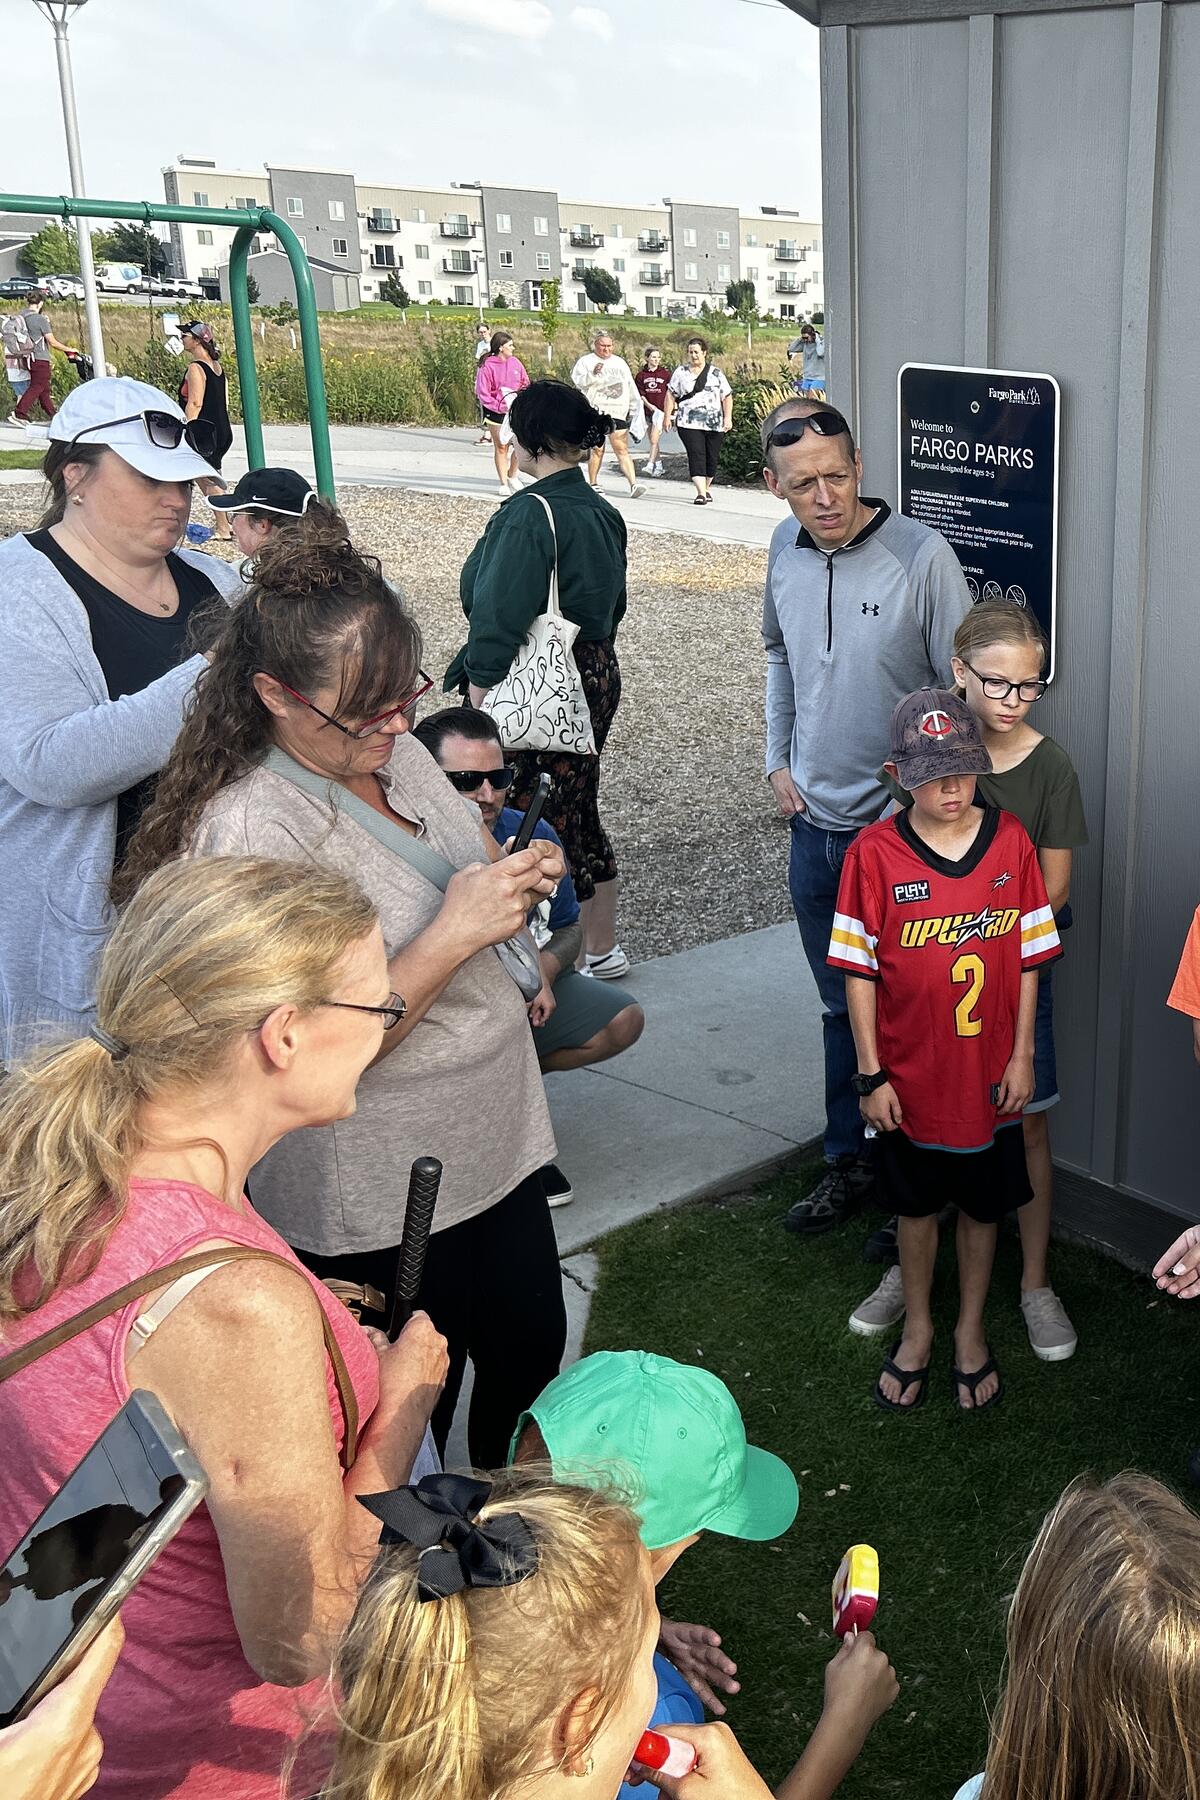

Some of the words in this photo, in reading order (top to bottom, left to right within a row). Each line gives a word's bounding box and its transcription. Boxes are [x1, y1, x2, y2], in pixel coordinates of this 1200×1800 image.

[911, 419, 944, 433] Welcome
[945, 424, 954, 434] to
[911, 436, 969, 461] FARGO
[975, 443, 1034, 469] PARKS
[911, 460, 940, 471] Playground
[940, 463, 964, 474] designed
[964, 466, 972, 475] for
[972, 469, 985, 477] ages
[988, 500, 1009, 508] CHILDREN
[894, 882, 928, 900] PLAY
[951, 953, 986, 1038] 2
